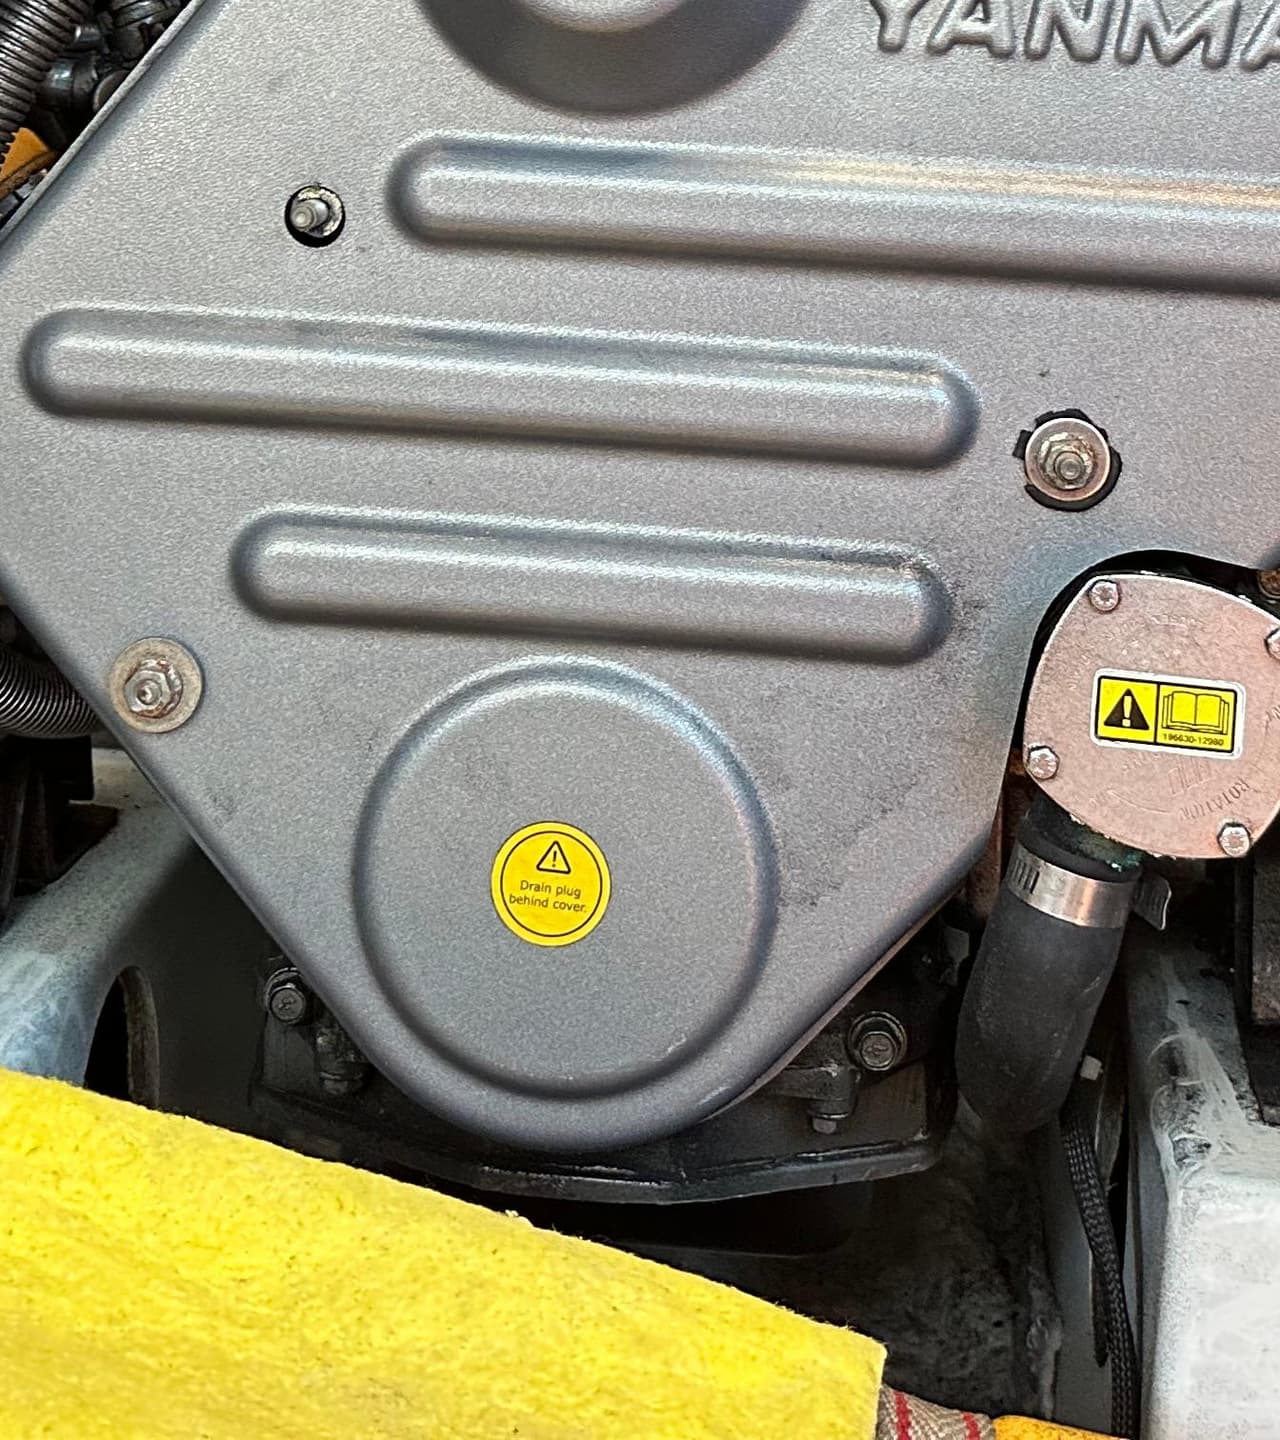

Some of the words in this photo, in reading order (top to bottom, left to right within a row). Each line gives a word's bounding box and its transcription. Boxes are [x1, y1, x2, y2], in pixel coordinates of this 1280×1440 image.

[520, 880, 551, 894] Drain
[556, 885, 581, 899] plug
[509, 893, 549, 908] behind
